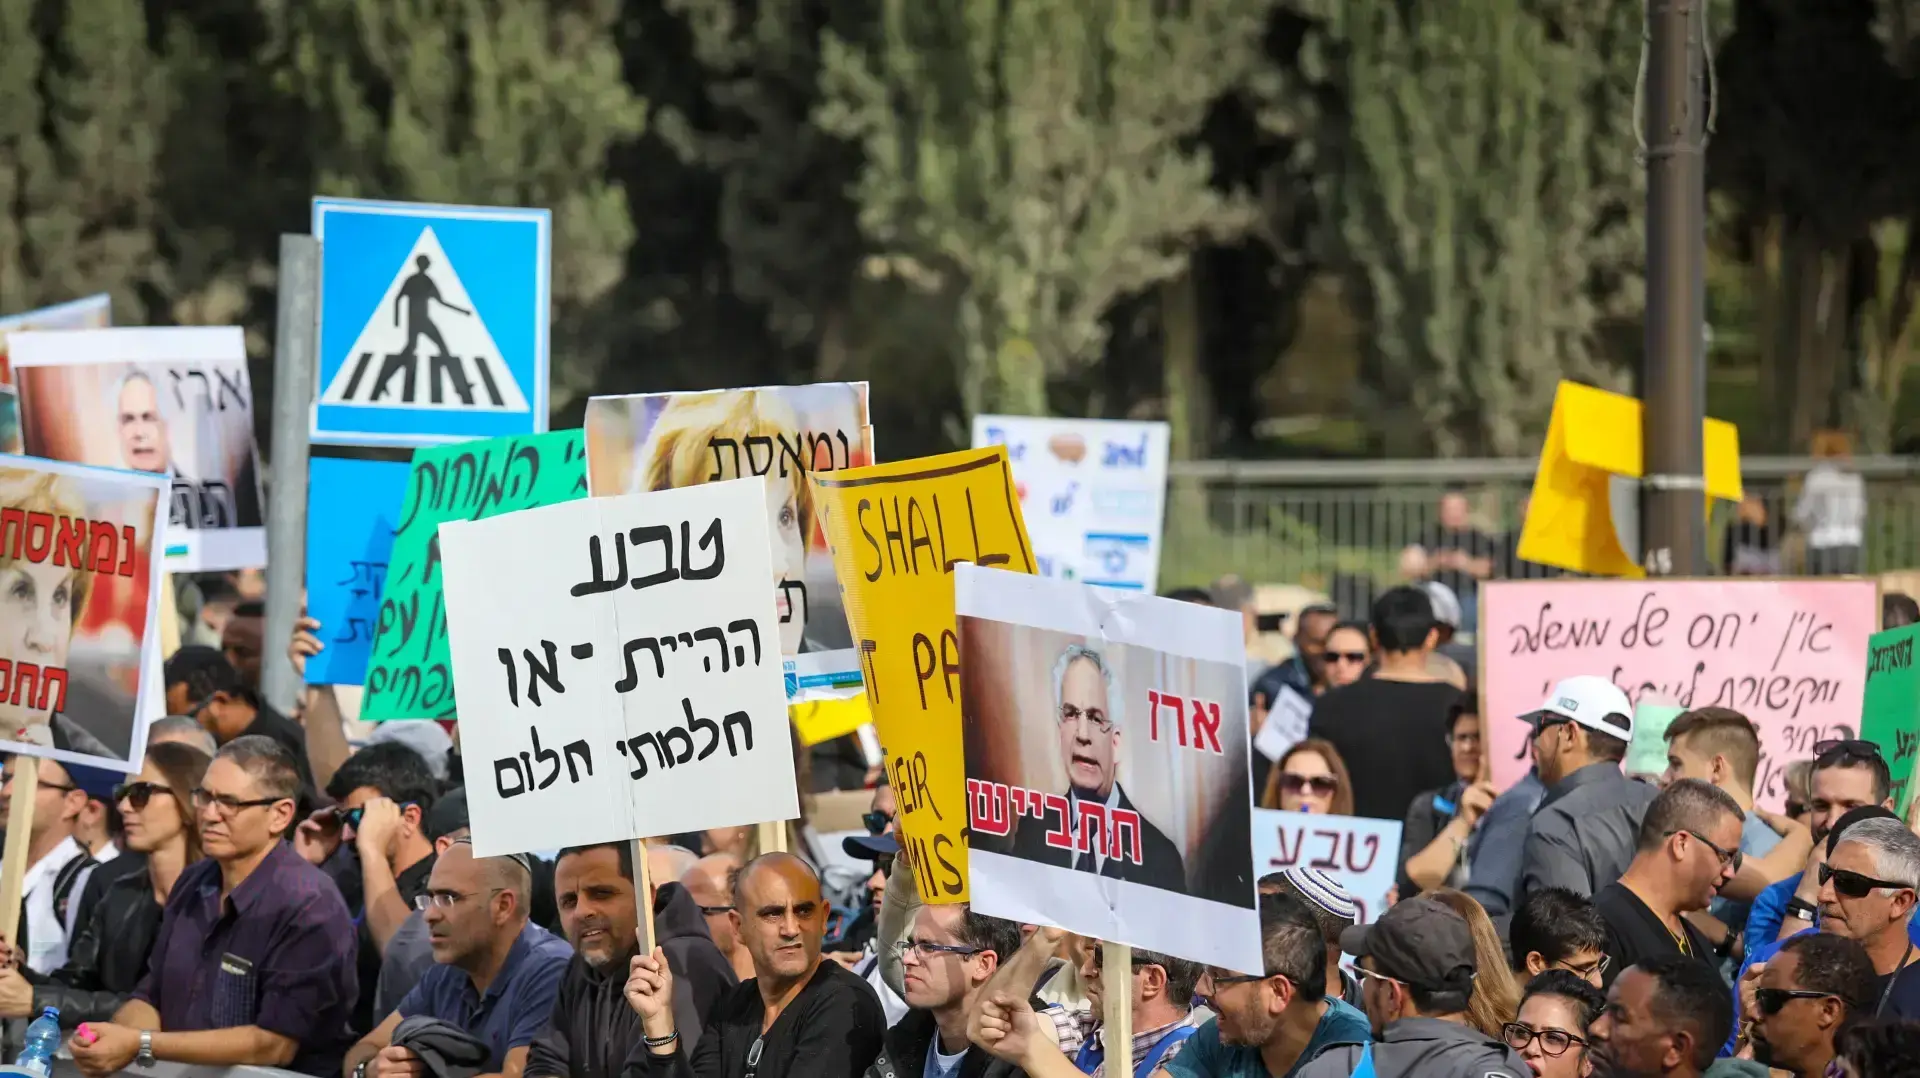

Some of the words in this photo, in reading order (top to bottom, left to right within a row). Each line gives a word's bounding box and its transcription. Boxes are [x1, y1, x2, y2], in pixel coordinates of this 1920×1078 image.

[570, 517, 726, 597] טבע
[857, 486, 1011, 583] SHALL
[614, 618, 761, 693] ההיית
[616, 697, 754, 781] חלמתי
[1147, 688, 1223, 755] ארז
[493, 725, 594, 799] חלום
[966, 778, 1143, 865] תתבייש
[1269, 824, 1380, 874] טבע
